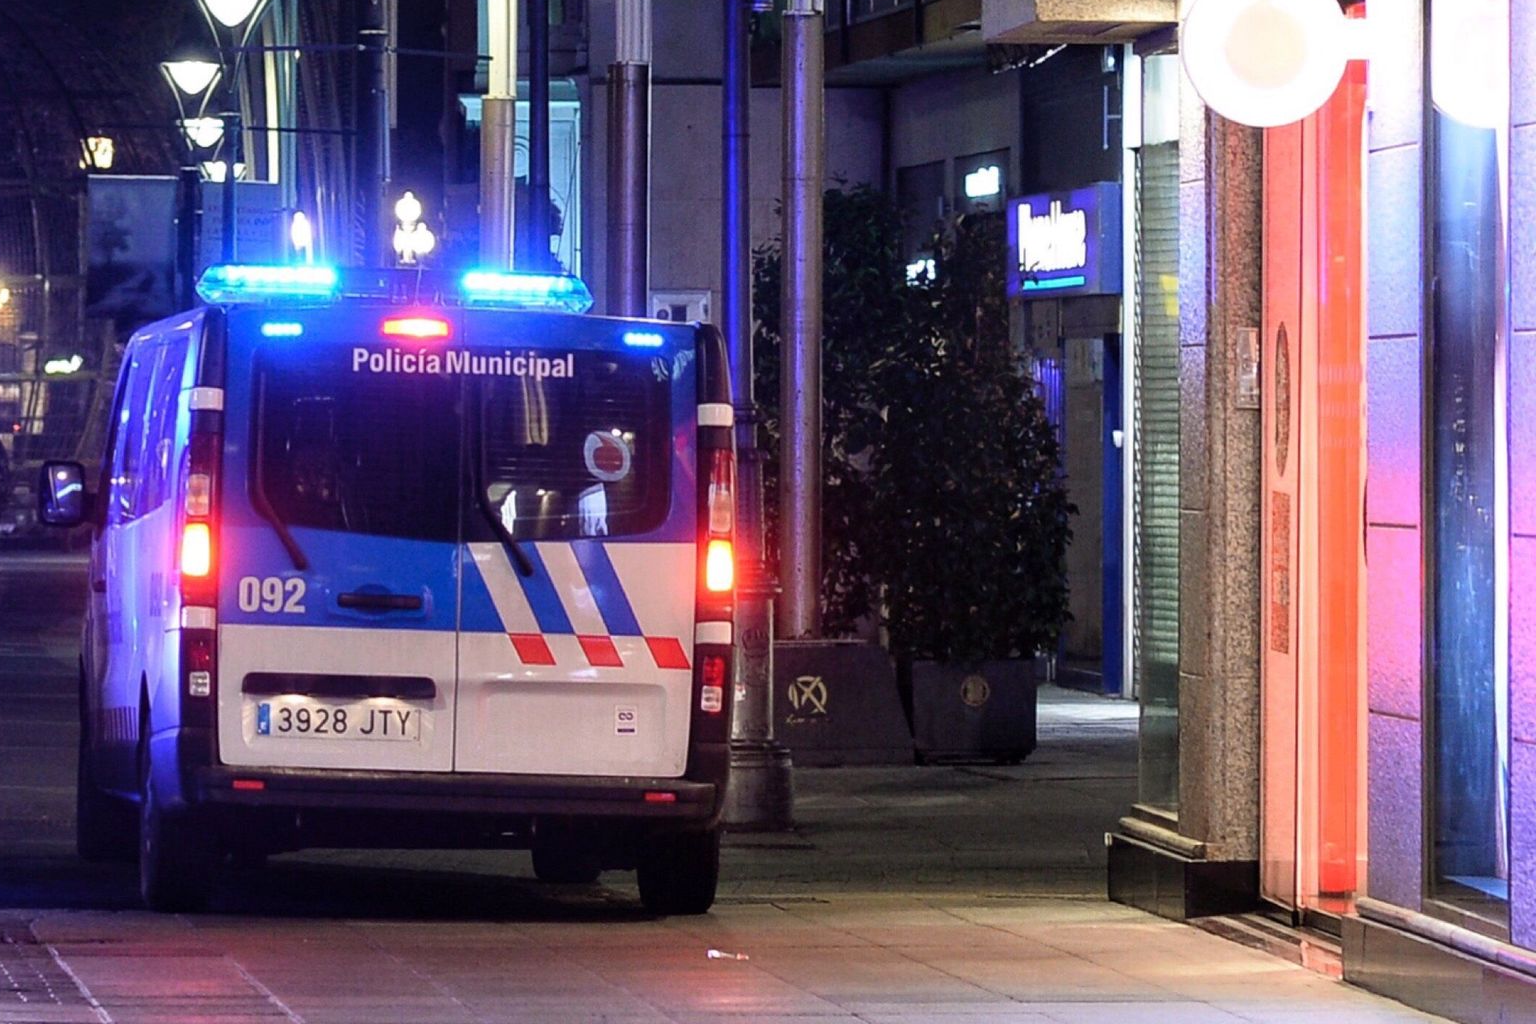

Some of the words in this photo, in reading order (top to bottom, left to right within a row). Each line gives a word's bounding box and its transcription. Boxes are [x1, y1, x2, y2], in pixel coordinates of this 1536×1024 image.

[352, 347, 440, 374] Policía
[445, 350, 574, 381] Municipal
[238, 575, 306, 614] 092
[278, 707, 348, 734] 3928
[360, 709, 412, 736] JTY
